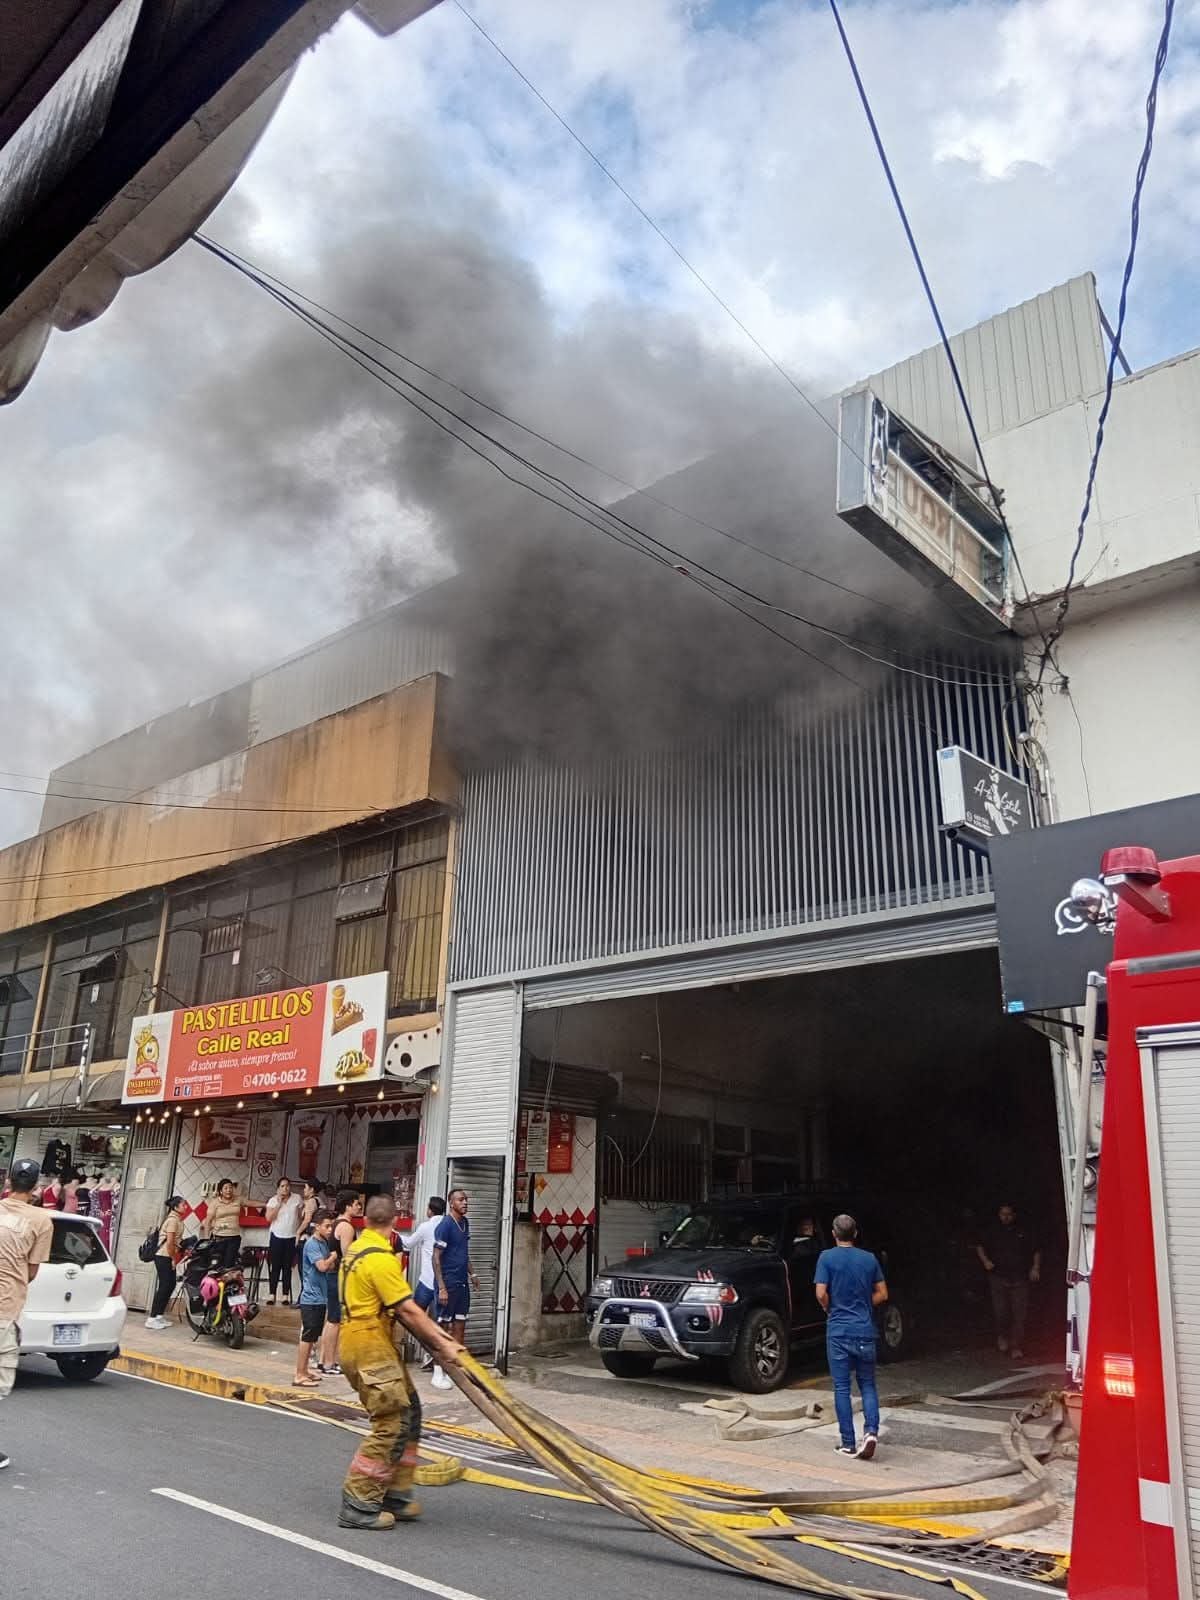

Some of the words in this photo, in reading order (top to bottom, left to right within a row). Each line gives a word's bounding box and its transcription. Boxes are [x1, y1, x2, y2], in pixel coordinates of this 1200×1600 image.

[181, 989, 313, 1034] PASTELILLOS
[197, 1032, 241, 1056] Calle
[246, 1023, 290, 1049] Real
[252, 1068, 307, 1086] 4706-0622
